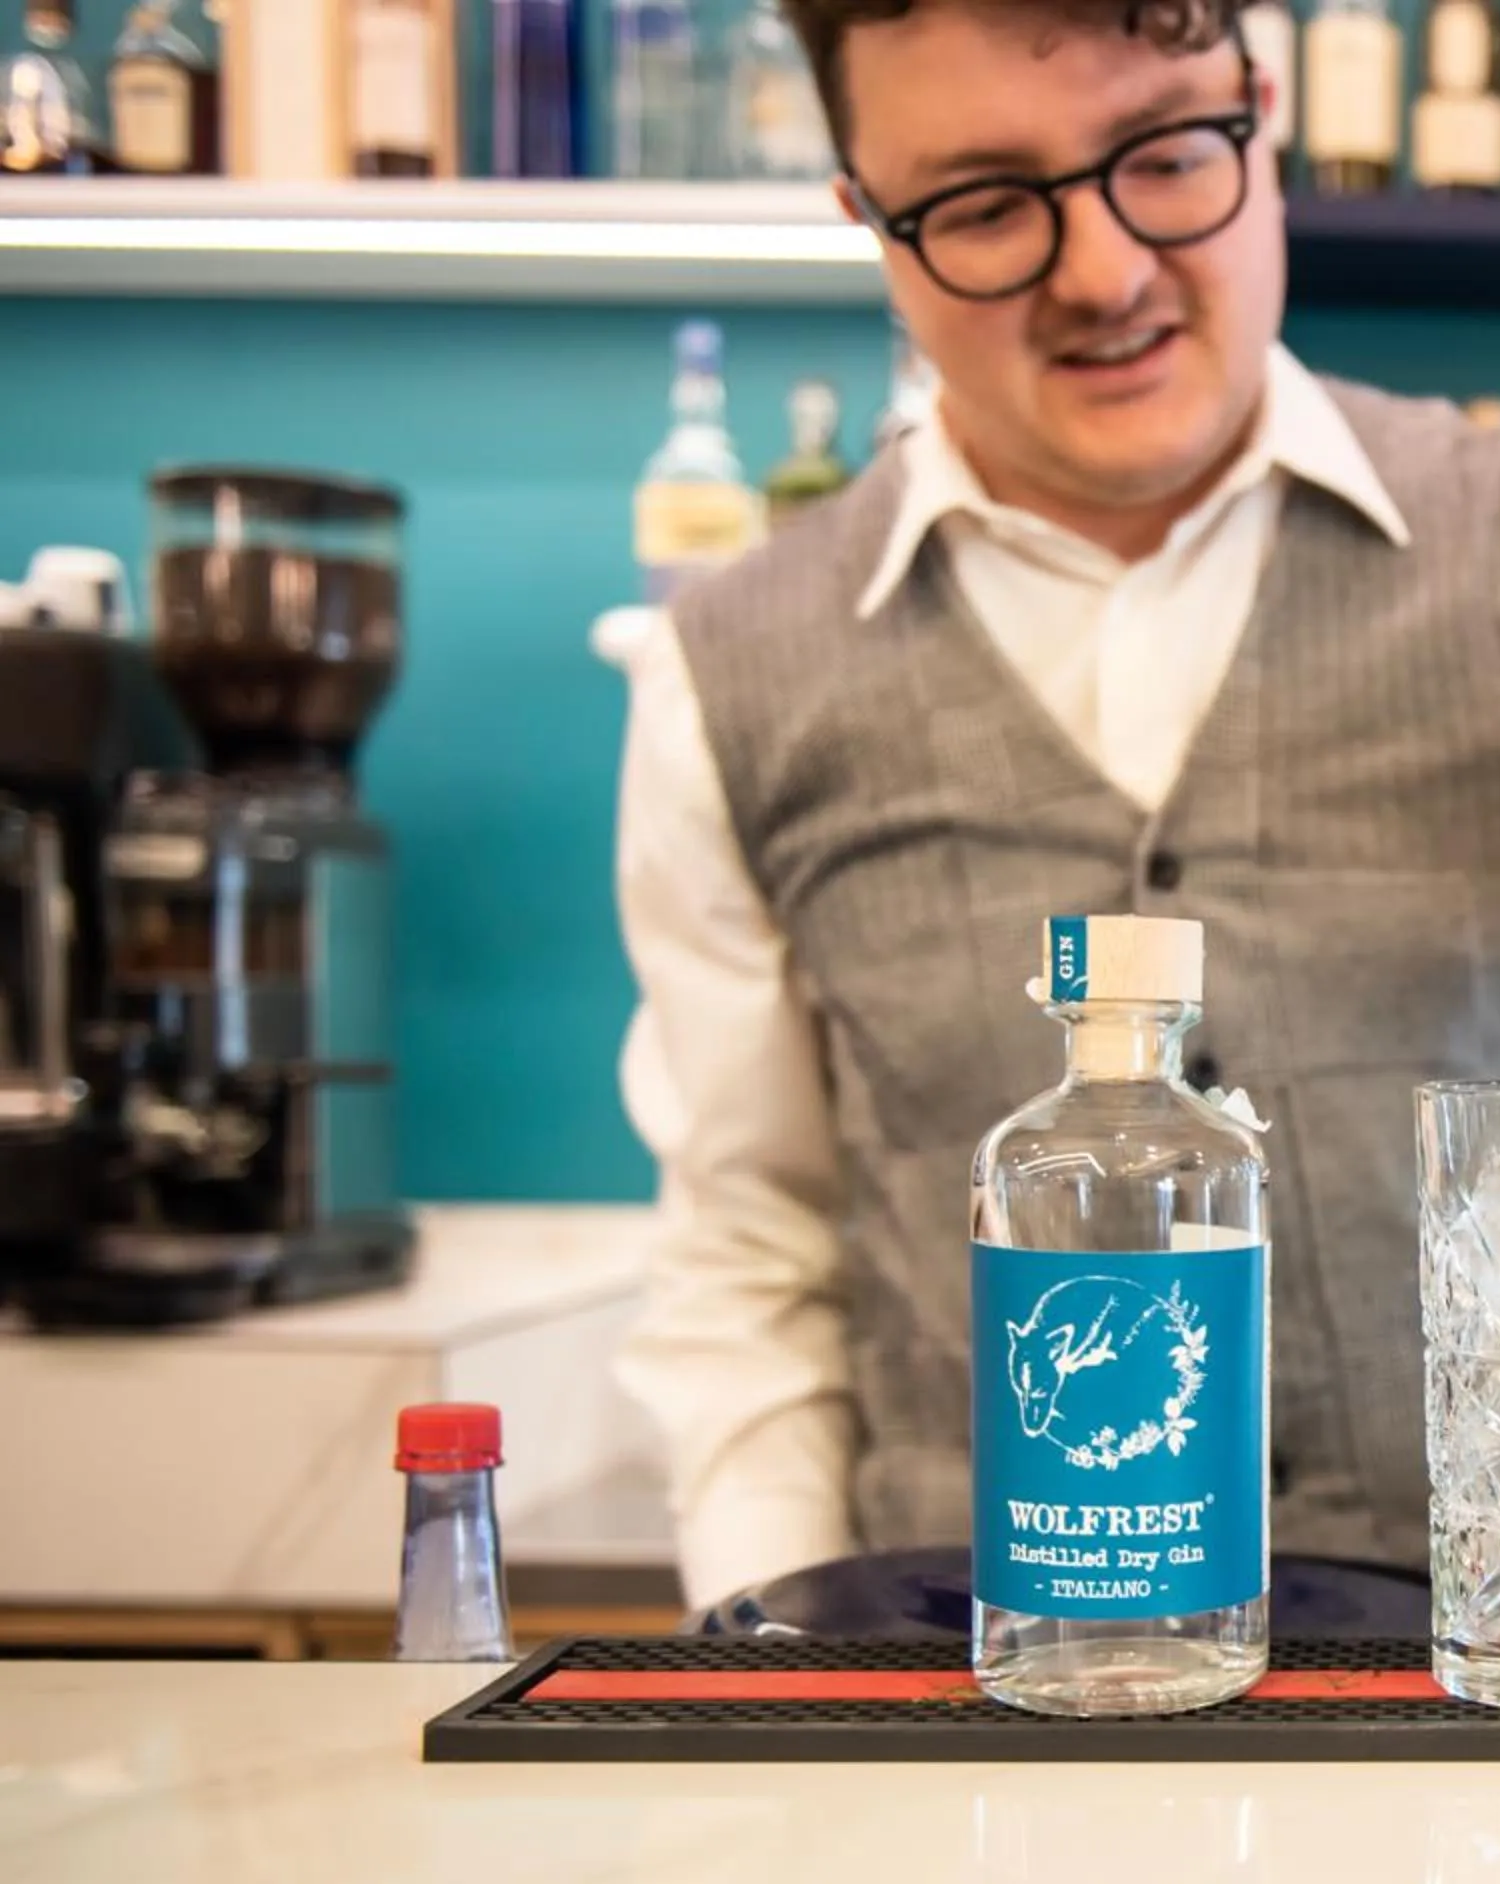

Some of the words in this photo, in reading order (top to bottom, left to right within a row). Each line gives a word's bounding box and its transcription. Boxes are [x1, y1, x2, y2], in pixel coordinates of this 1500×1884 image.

[1058, 935, 1075, 980] GIN
[1007, 1499, 1205, 1537] WOLFREST
[1008, 1542, 1109, 1569] Distilled
[1116, 1549, 1160, 1573] Dry
[1167, 1543, 1205, 1565] Gin
[1051, 1578, 1152, 1599] ITALIANO
